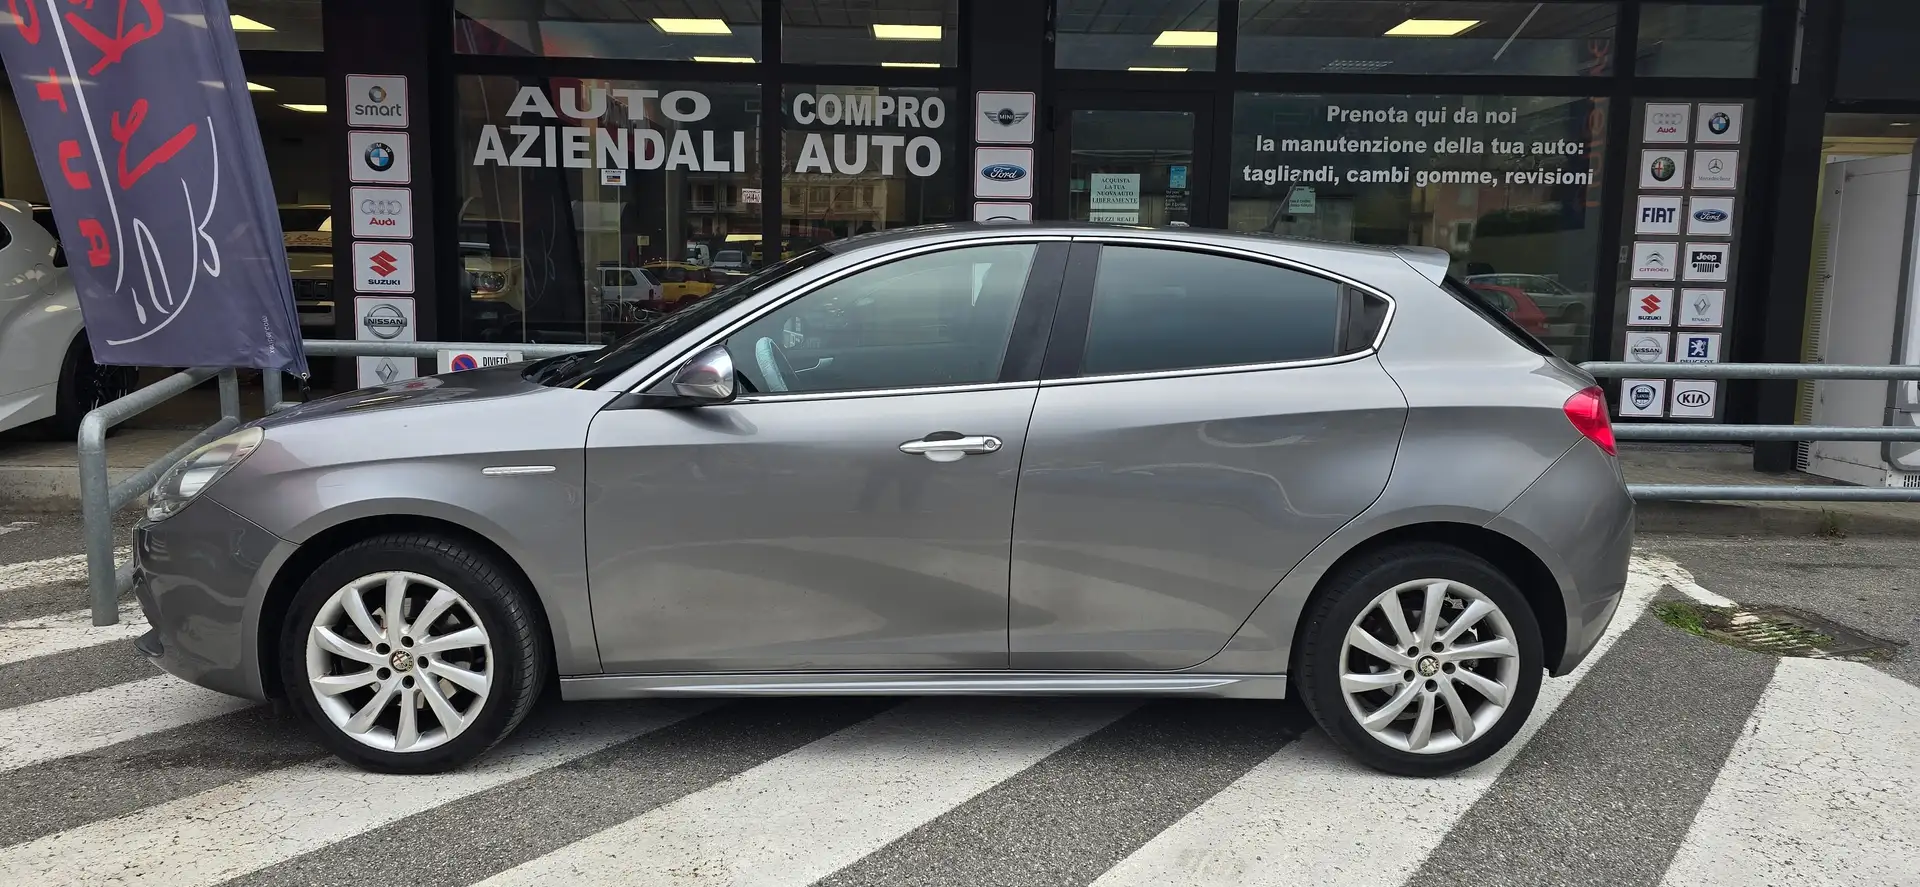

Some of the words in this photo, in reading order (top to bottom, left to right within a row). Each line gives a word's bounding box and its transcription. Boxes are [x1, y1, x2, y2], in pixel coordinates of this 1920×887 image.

[355, 103, 402, 117] smart
[505, 86, 711, 122] AUTO
[793, 92, 945, 129] COMPRO
[1327, 106, 1408, 124] Prenota
[1415, 106, 1446, 128] qui
[1453, 107, 1479, 124] da
[1485, 108, 1517, 124] noi
[473, 125, 744, 172] AZIENDALI
[1256, 135, 1274, 152] la
[1281, 137, 1427, 153] manutenzione
[1433, 137, 1484, 154] della
[1491, 140, 1524, 154] tua
[1531, 139, 1585, 155] auto:
[795, 133, 942, 177] AUTO
[990, 166, 1017, 179] Ford
[1243, 165, 1339, 187] tagliandi,
[1346, 166, 1409, 183] cambi
[1416, 171, 1498, 188] gomme,
[1505, 168, 1594, 185] revisioni
[369, 217, 396, 226] Audi
[1642, 207, 1676, 223] FIAT
[1700, 211, 1721, 221] Ford
[1696, 252, 1717, 262] Jeep
[368, 278, 401, 286] SUZUKI
[368, 317, 403, 326] NISSAN
[1682, 394, 1704, 404] KIA
